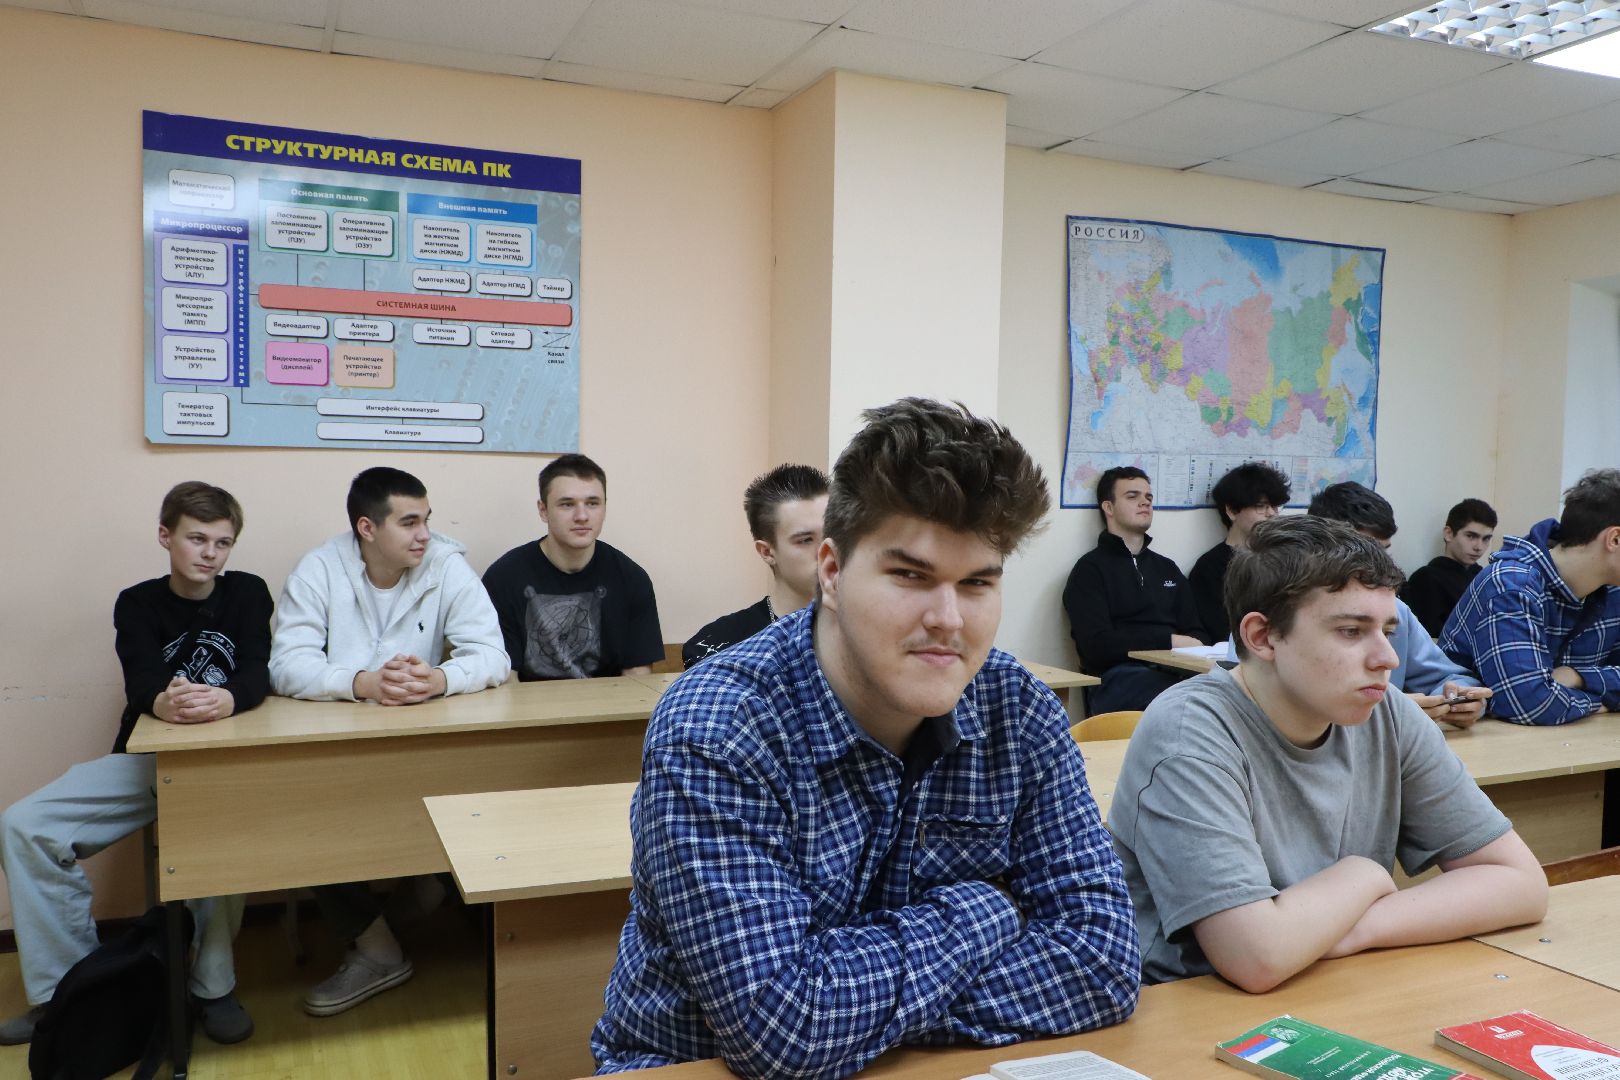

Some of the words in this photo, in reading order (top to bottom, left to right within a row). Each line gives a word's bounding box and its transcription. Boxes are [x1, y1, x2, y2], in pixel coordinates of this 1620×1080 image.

[225, 134, 397, 168] СТРУКТУРНАЯ
[400, 153, 478, 175] СХЕМА
[482, 162, 512, 179] ПК
[290, 188, 334, 200] Основная
[336, 193, 368, 202] память
[438, 202, 476, 212] Внешняя
[477, 206, 508, 215] память
[276, 212, 316, 221] Постоянное
[160, 217, 243, 234] Микропроцессор
[271, 220, 322, 230] запоминающее
[342, 218, 385, 226] Оперативное
[278, 229, 316, 237] устройство
[339, 226, 389, 234] запоминающее
[423, 225, 460, 233] Накопитель
[1074, 226, 1140, 239] РОССИЯ
[486, 230, 522, 239] Накопитель
[288, 237, 306, 245] (ПЗУ)
[170, 246, 219, 256] Арифметико-
[438, 249, 464, 257] (НЖМД)
[174, 255, 214, 263] логическое
[503, 254, 524, 262] (НГМД)
[175, 262, 214, 272] устройство
[185, 271, 204, 279] (АЛУ)
[418, 276, 444, 284] Адаптер
[482, 280, 507, 289] Адаптер
[175, 293, 214, 303] Микропро-
[176, 303, 214, 311] цессорная
[377, 300, 429, 311] СИСТЕМНАЯ
[431, 304, 457, 312] ШИНА
[184, 318, 206, 326] (МПП)
[273, 321, 321, 331] Видеоадаптер
[175, 346, 215, 354] Устройство
[174, 354, 217, 363] управления
[272, 355, 322, 364] Видеомонитор
[188, 362, 203, 370] (УУ)
[281, 363, 313, 371] (дисплей)
[178, 403, 214, 411] Генератор
[176, 419, 215, 427] импульсов
